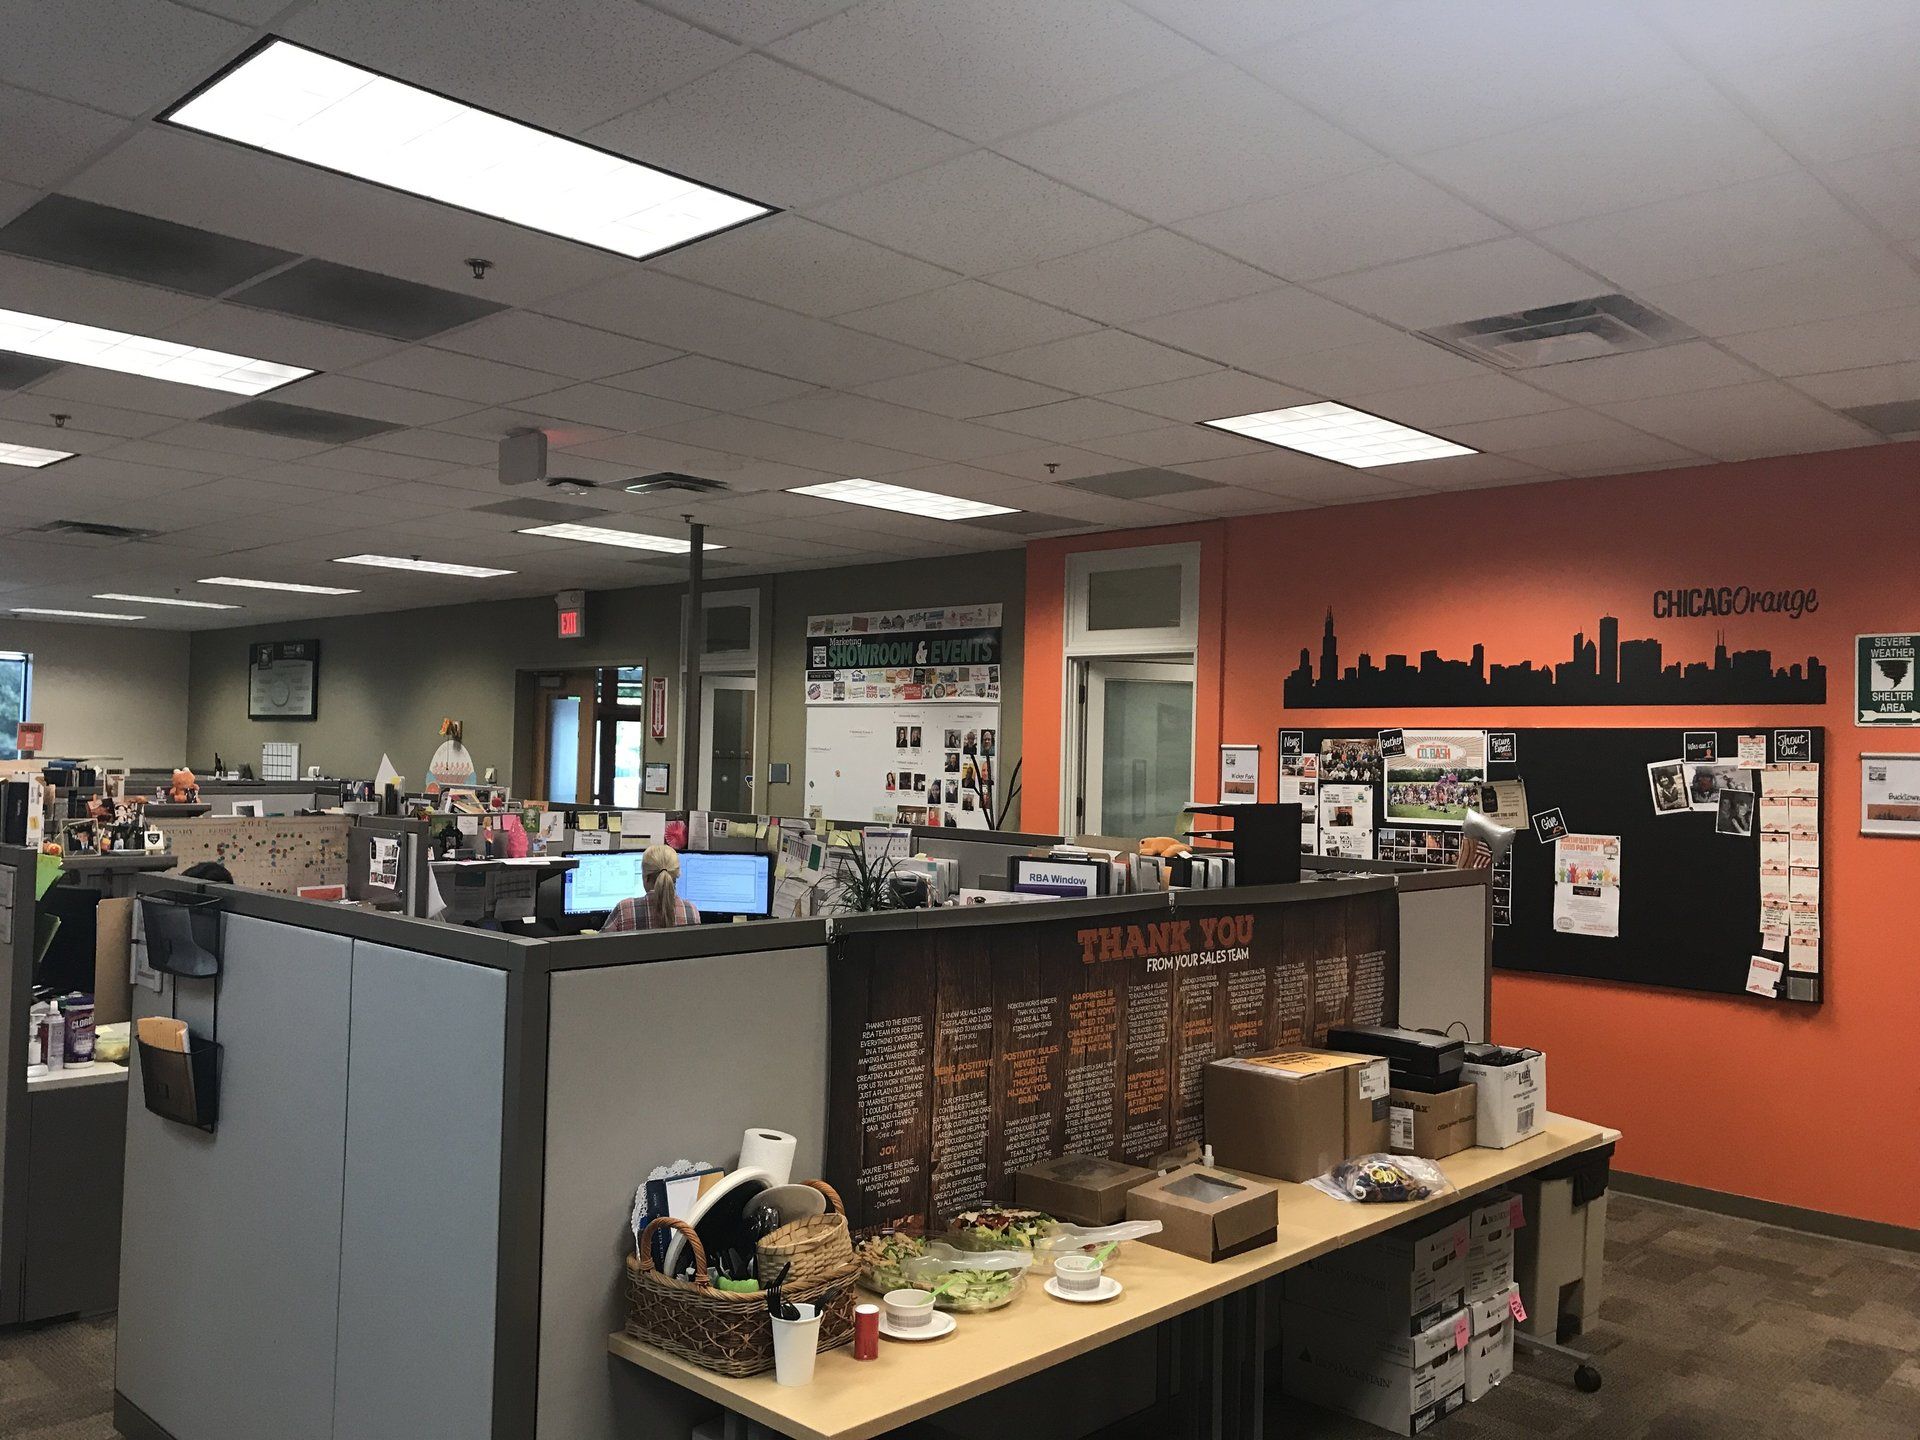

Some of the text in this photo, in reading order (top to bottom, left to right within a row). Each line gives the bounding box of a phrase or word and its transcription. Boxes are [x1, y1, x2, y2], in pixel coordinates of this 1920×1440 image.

[1653, 586, 1819, 619] CHICAGOrange
[561, 612, 577, 635] EXIT
[829, 637, 862, 648] Marketing
[1874, 637, 1911, 647] SEVERE
[828, 642, 913, 668] SHOWROOM
[930, 638, 993, 665] EVENTS
[1870, 648, 1915, 658] WEATHER
[1872, 691, 1913, 701] SHELTER
[1879, 703, 1906, 712] AREA
[1381, 736, 1402, 749] Gather
[1430, 748, 1450, 759] BASH
[1780, 746, 1799, 756] Out
[1541, 816, 1559, 831] Give
[1029, 873, 1087, 885] RBA Window
[1077, 914, 1255, 964] THANK YOU
[1146, 947, 1249, 972] FROM YOUR SALES TEAM
[1072, 988, 1114, 1002] HAPPINESS IS
[1070, 997, 1116, 1011] NOT THE BELIEF
[1070, 1010, 1086, 1020] THAT
[1087, 1009, 1097, 1017] WE
[865, 1021, 885, 1030] THANKS
[891, 1018, 901, 1026] THE
[902, 1015, 922, 1025] ENTIRE
[1080, 1016, 1105, 1027] NEED TO
[1105, 1023, 1117, 1032] THE
[1229, 1020, 1257, 1031] HAPPINESS
[875, 1028, 890, 1037] TEAM
[891, 1026, 900, 1035] FOR
[1072, 1033, 1110, 1046] REALIZATION
[1071, 1045, 1086, 1056] THAT
[1087, 1043, 1097, 1053] WE
[1014, 1056, 1049, 1069] NEVER LET
[1015, 1065, 1046, 1077] NEGATIVE
[1128, 1069, 1159, 1082] HAPPINESS
[857, 1082, 868, 1091] FOR
[869, 1081, 876, 1089] US
[876, 1080, 883, 1088] TO
[914, 1073, 925, 1081] AND
[1012, 1073, 1048, 1087] THOUGHTS
[1128, 1082, 1139, 1091] THE
[860, 1090, 872, 1100] JUST
[893, 1085, 903, 1094] OLD
[904, 1082, 923, 1092] THANKS
[1007, 1082, 1052, 1097] HIJACK YOUR
[1124, 1084, 1168, 1100] FEELS STRIVING
[1128, 1097, 1148, 1108] AFTER
[861, 1112, 891, 1125] SOMETHING
[912, 1107, 919, 1115] TO
[883, 1162, 893, 1171] THE
[894, 1158, 914, 1169] ENGINE
[857, 1165, 920, 1186] THAT KEEPS THIS THING
[885, 1176, 910, 1188] FORWARD
